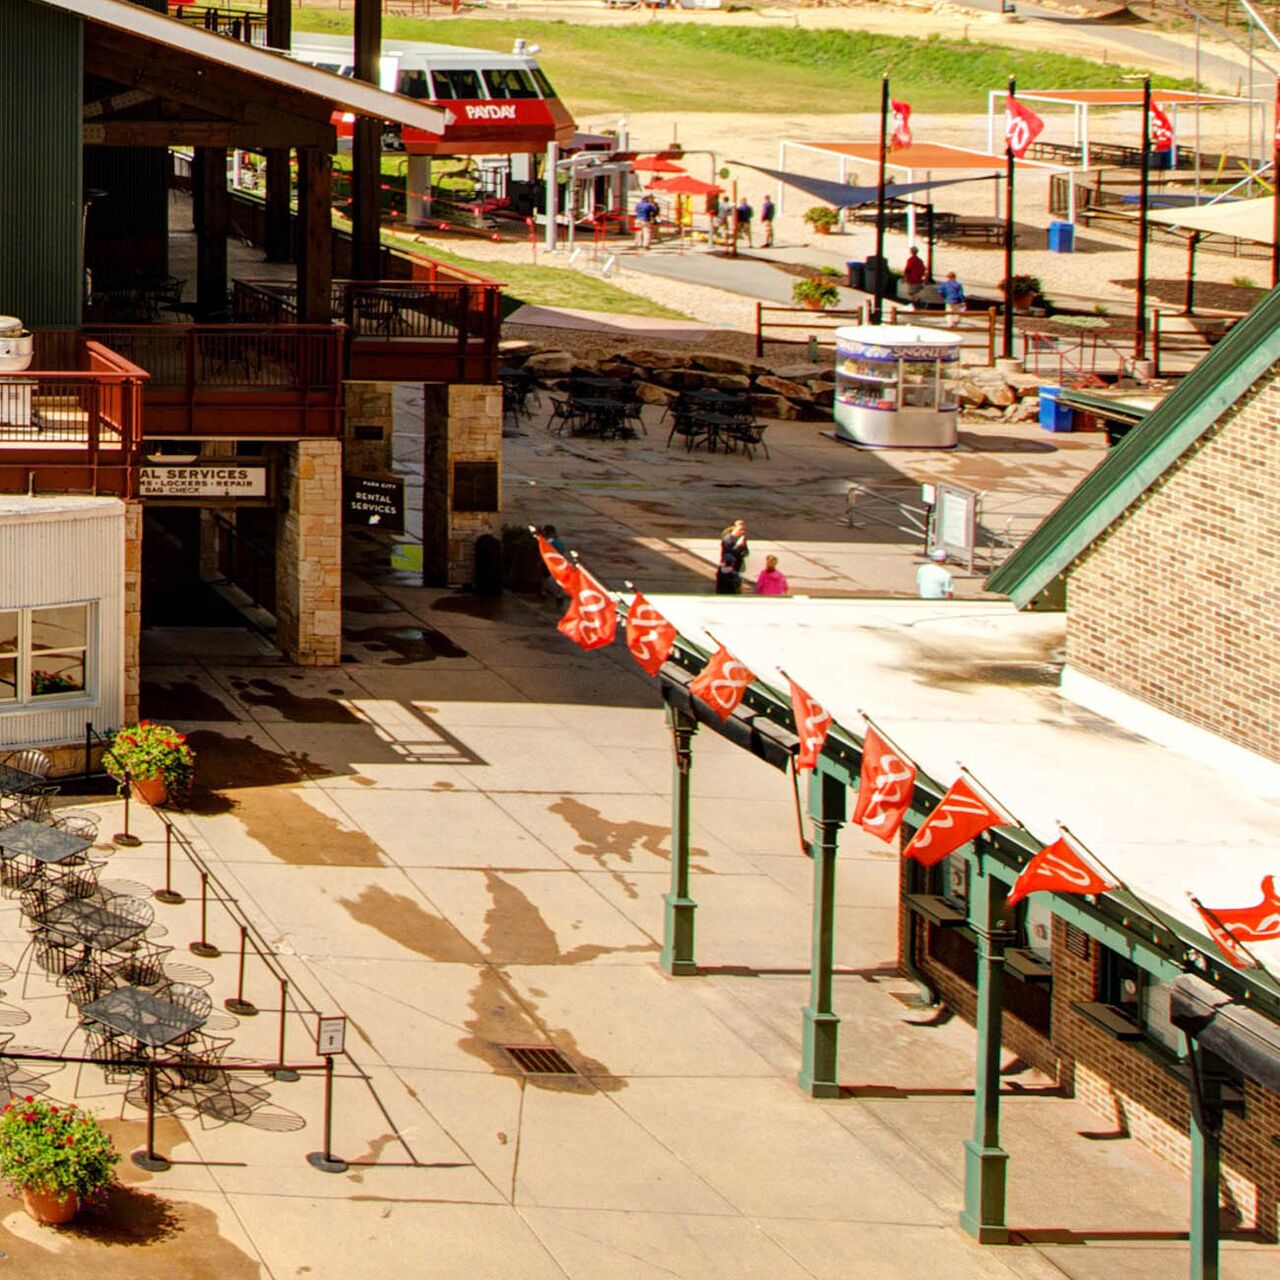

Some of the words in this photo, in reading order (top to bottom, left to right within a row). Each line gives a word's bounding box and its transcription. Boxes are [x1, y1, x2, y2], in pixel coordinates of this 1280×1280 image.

[465, 104, 517, 120] PAYDAY
[166, 469, 249, 480] SERVICES
[355, 491, 392, 504] RENTAL
[351, 501, 397, 515] SERVICES
